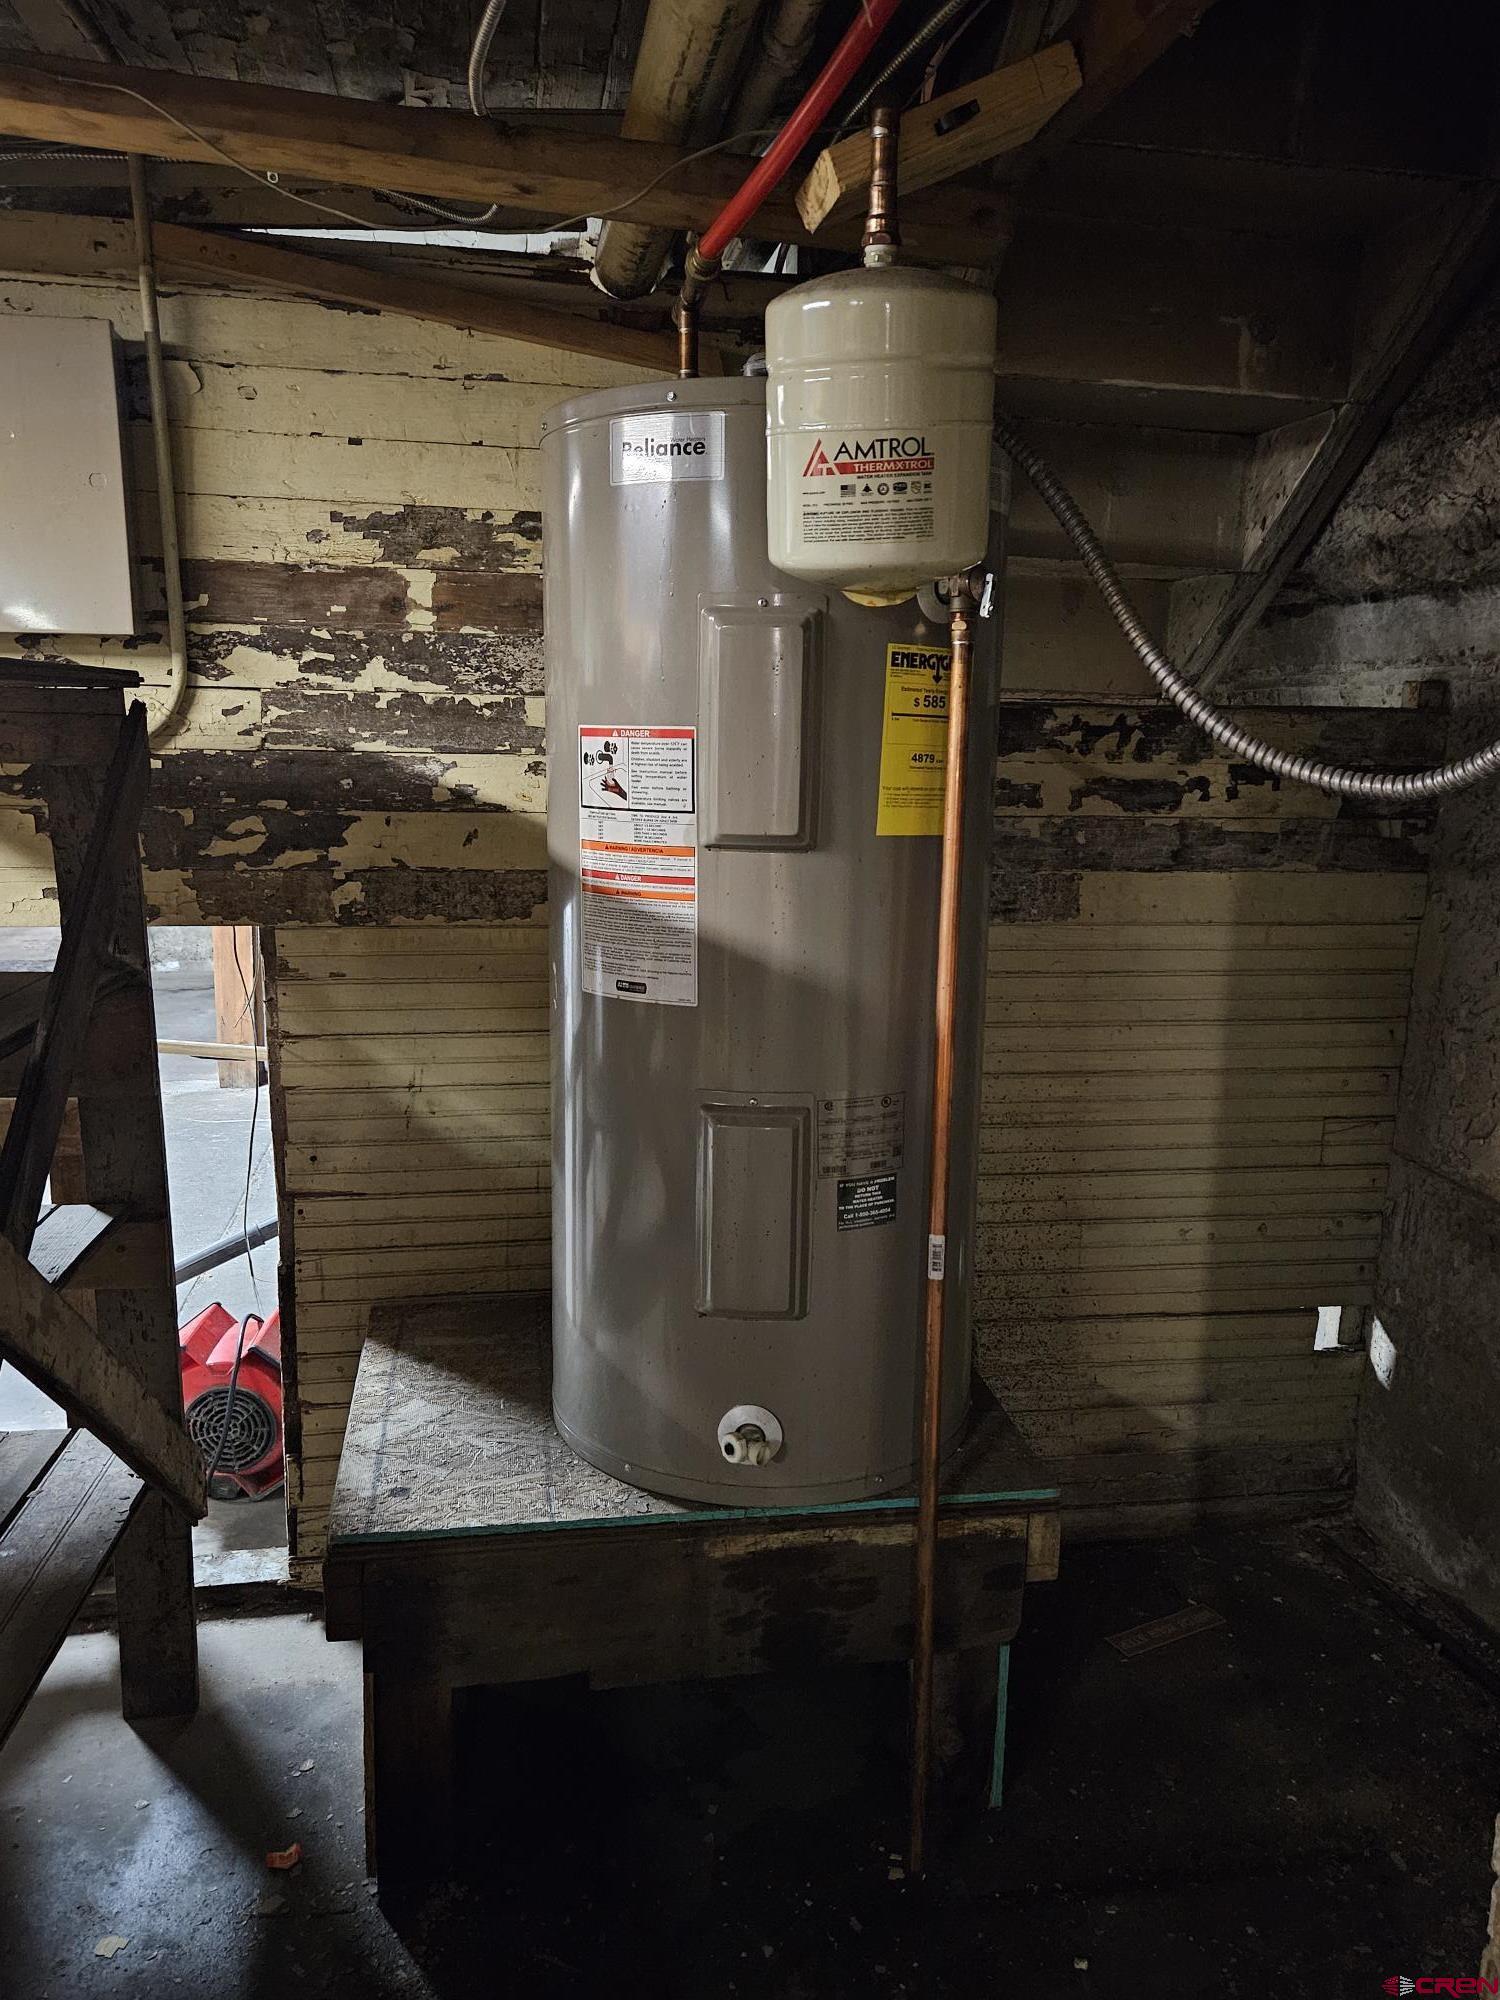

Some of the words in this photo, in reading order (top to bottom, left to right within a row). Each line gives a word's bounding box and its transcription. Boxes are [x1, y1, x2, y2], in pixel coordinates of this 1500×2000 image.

[623, 438, 706, 457] Reliance
[834, 437, 931, 461] AMTROL
[923, 695, 946, 708] 585
[912, 753, 935, 763] 4879
[631, 846, 664, 854] ADVERTENCIA
[620, 874, 642, 882] DANGER
